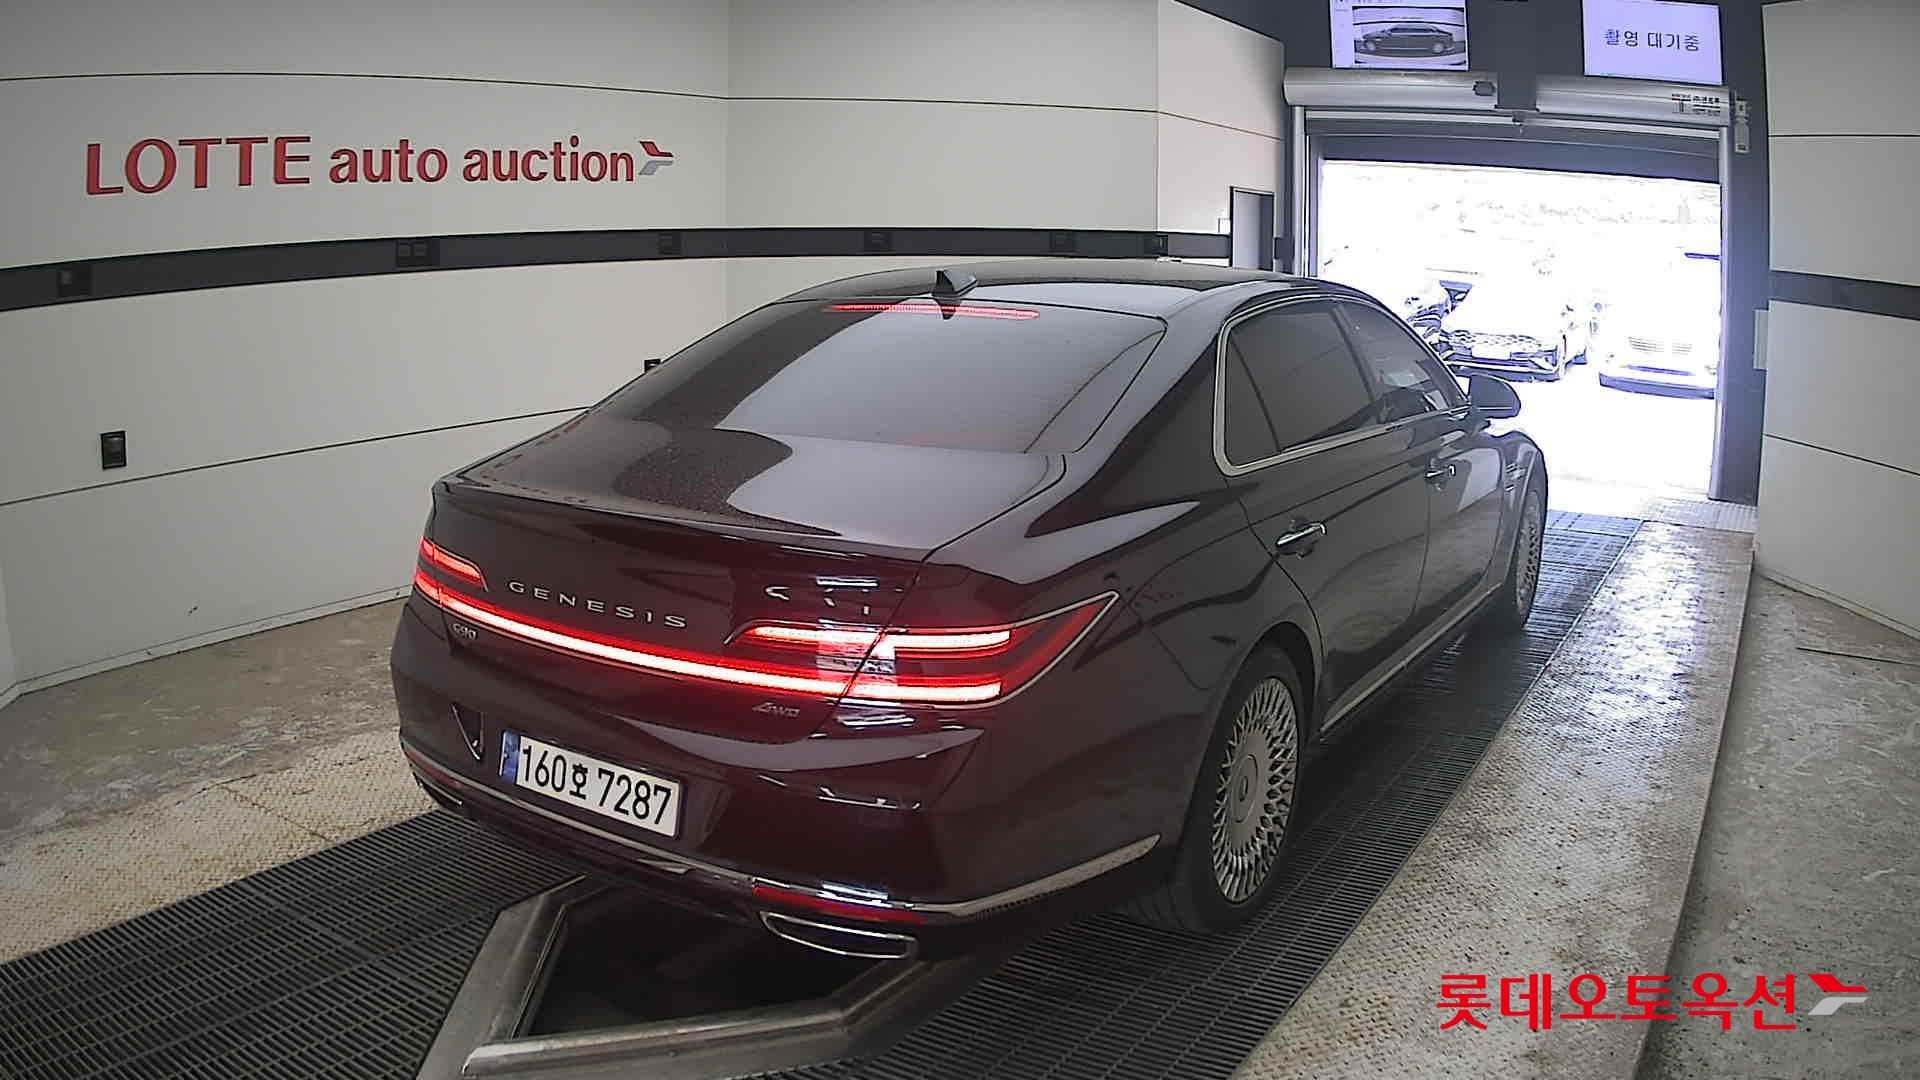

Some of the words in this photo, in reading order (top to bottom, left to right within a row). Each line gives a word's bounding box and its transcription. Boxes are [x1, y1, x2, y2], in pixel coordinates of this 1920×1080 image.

[1647, 32, 1700, 52] 대기중
[86, 136, 311, 195] LOTTE
[329, 138, 448, 184] auto
[462, 135, 634, 183] auction
[508, 581, 687, 629] GENESIS
[452, 622, 478, 641] G90
[522, 745, 589, 801] 160호
[597, 767, 672, 825] 7287
